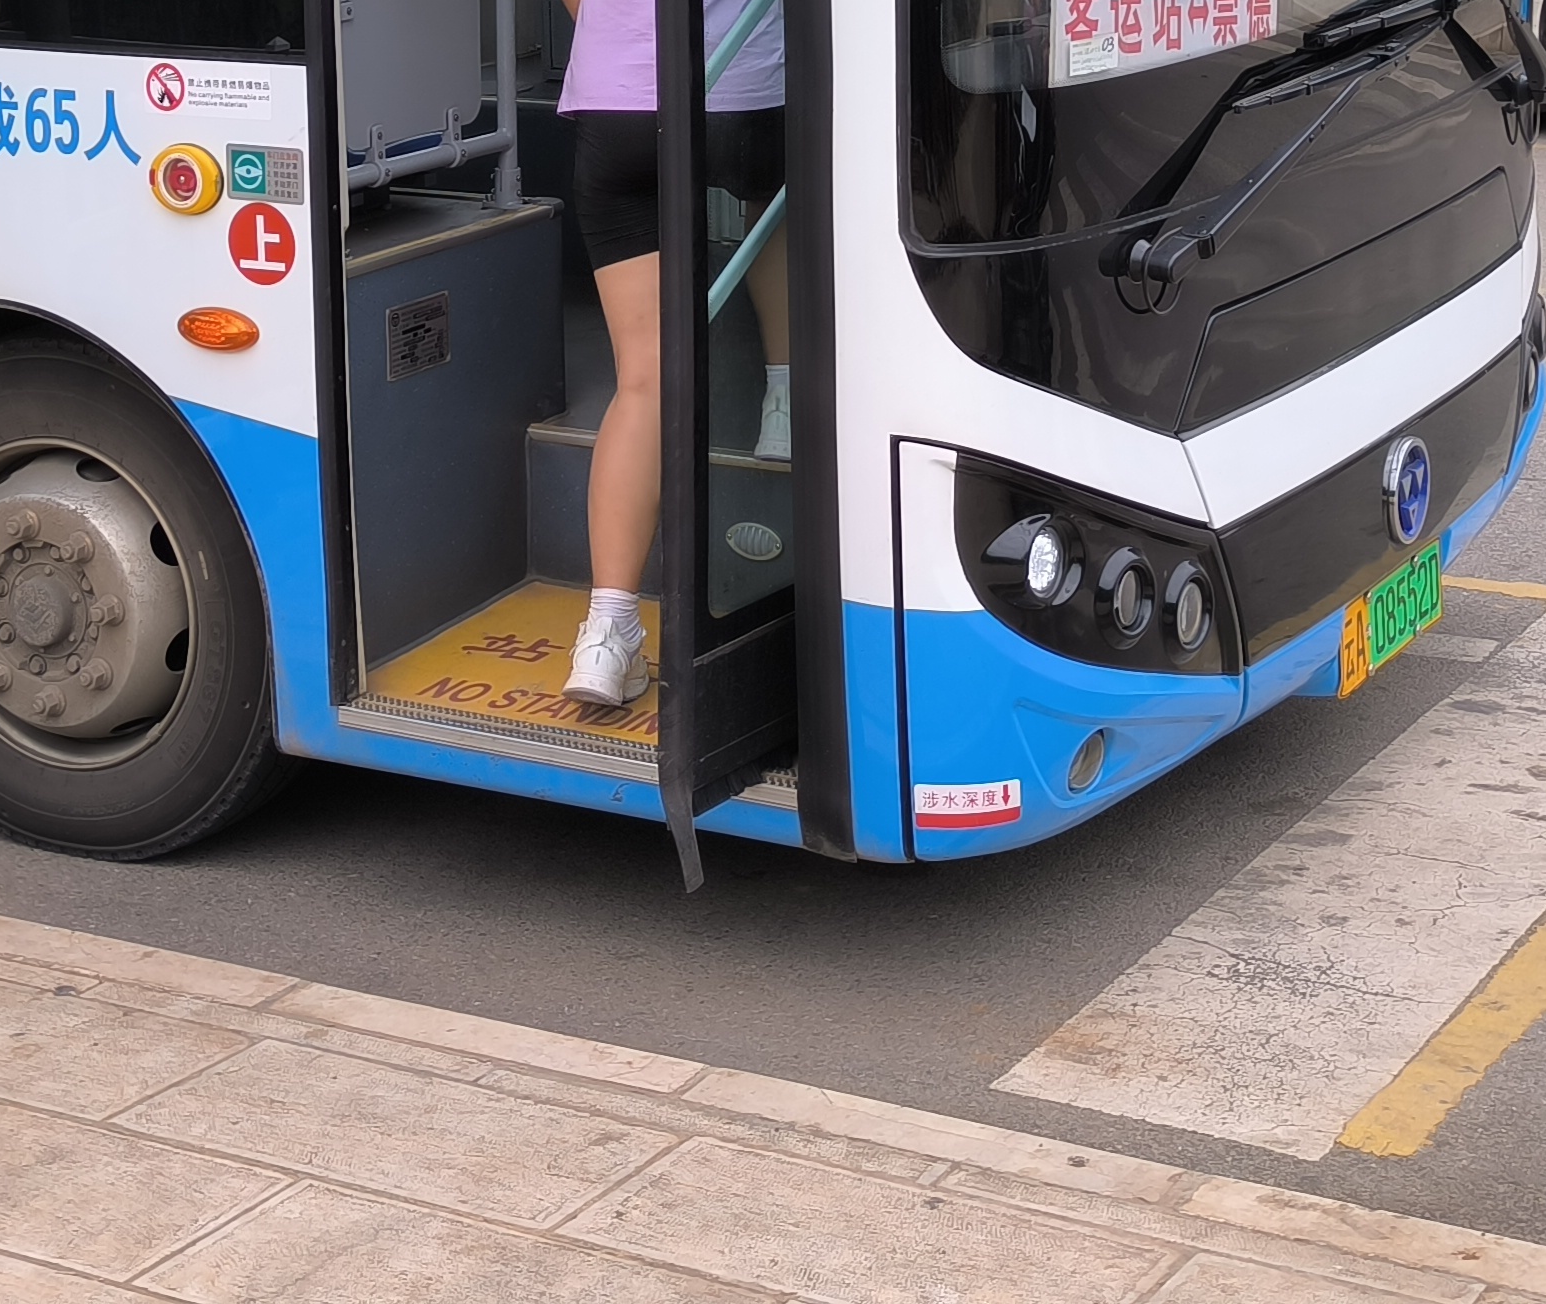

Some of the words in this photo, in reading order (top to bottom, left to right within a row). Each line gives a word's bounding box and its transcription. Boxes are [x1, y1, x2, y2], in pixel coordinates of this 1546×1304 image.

[1101, 36, 1115, 53] 03
[240, 215, 286, 272] 上
[416, 676, 492, 703] NO
[487, 689, 659, 735] STANDIN
[922, 790, 998, 809] 涉水深度
